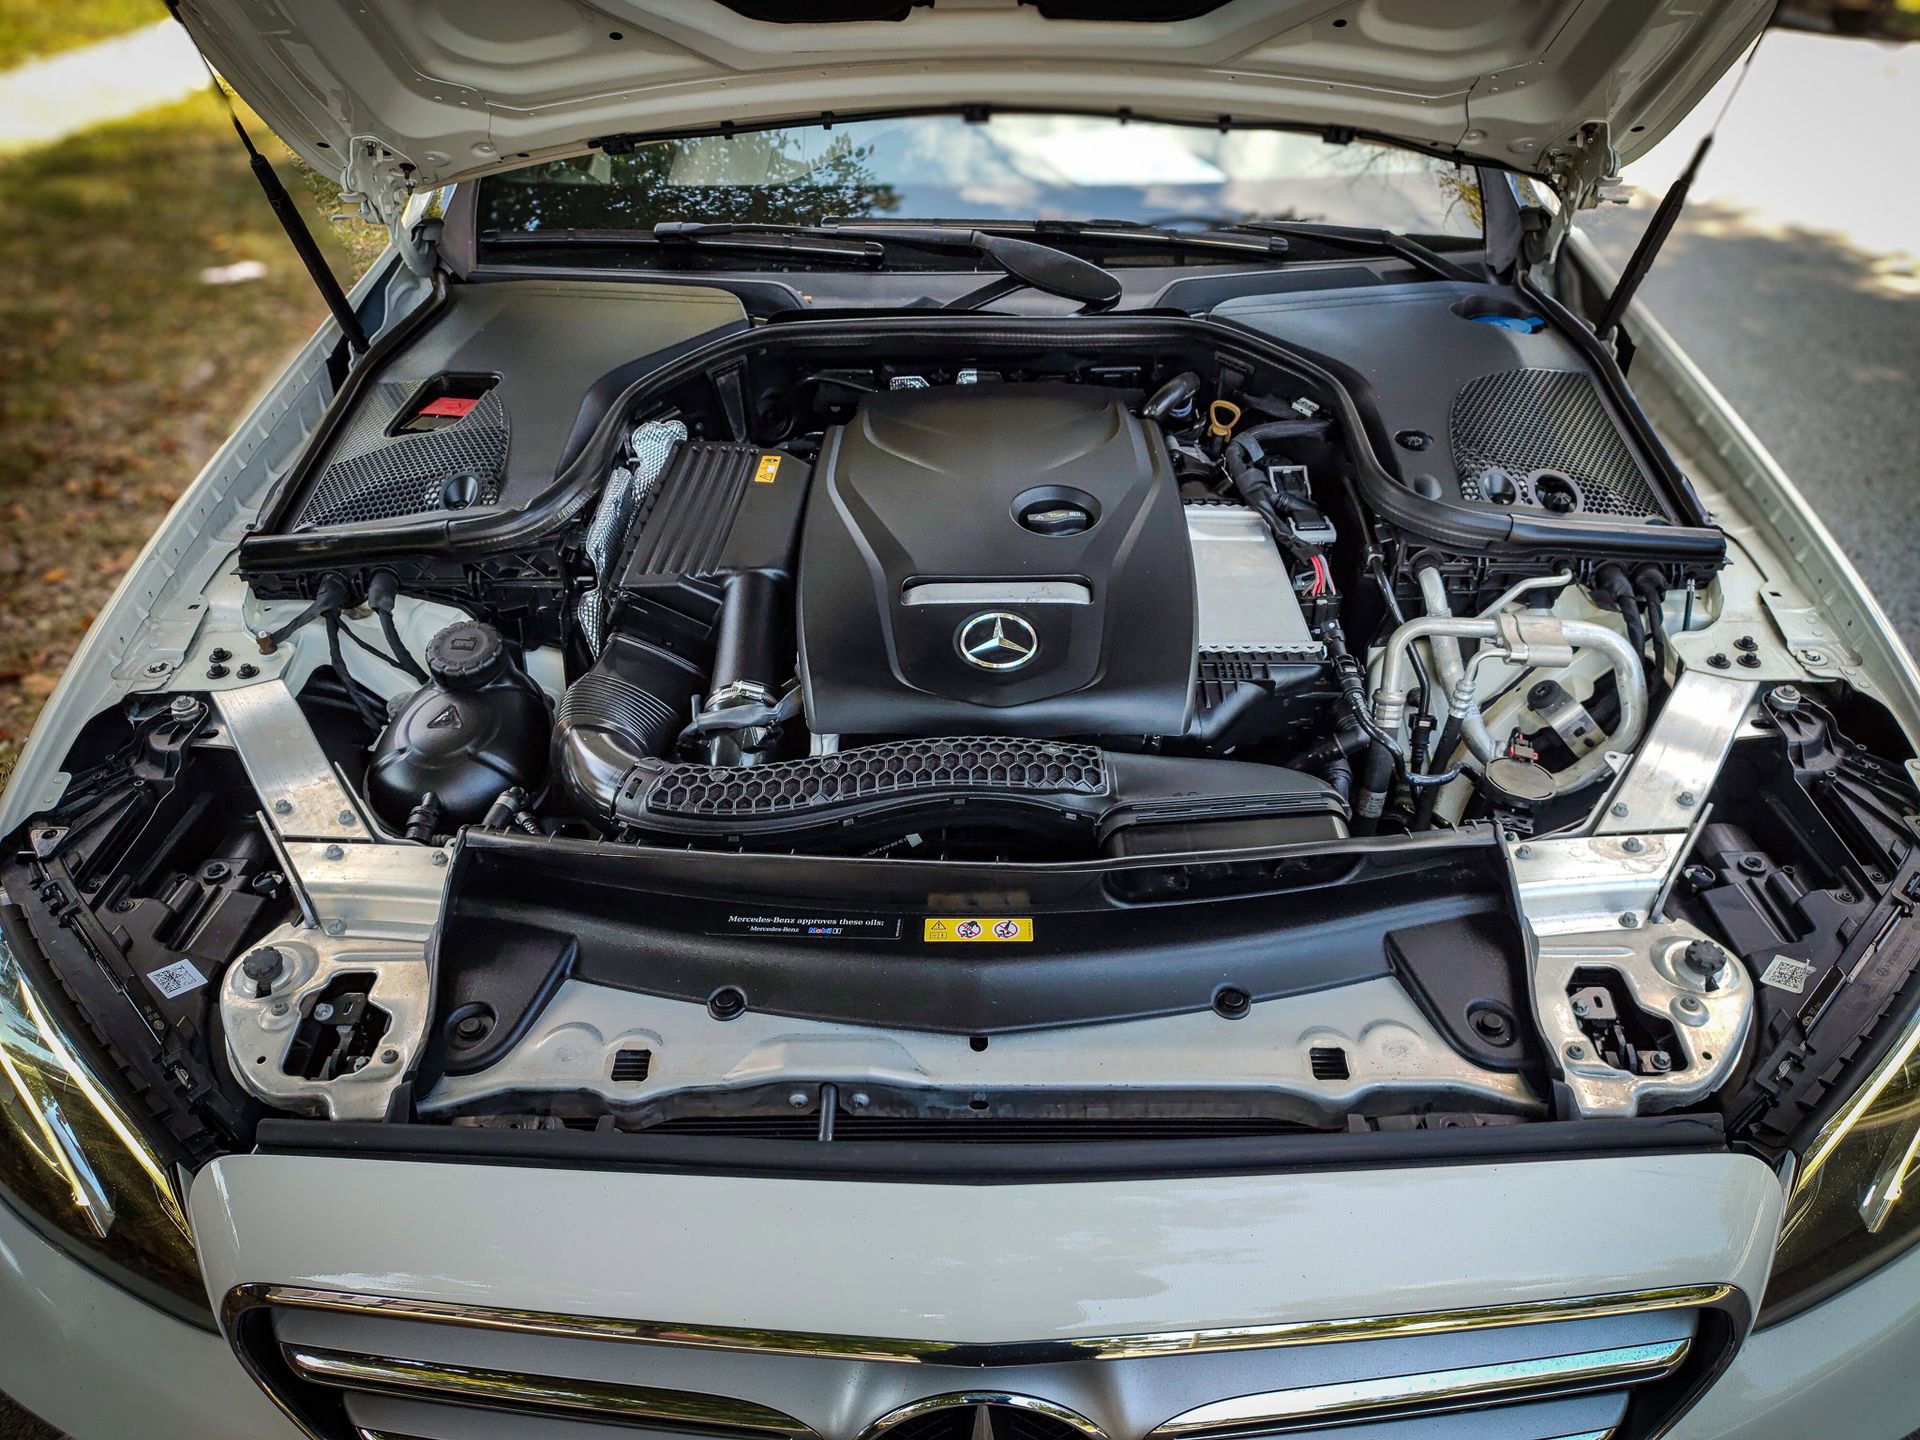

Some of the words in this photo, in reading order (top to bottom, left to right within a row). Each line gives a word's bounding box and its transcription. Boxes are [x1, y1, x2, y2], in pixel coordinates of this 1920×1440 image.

[728, 915, 796, 924] Mercedes-Benz
[797, 918, 837, 926] approves
[839, 918, 864, 926] these
[749, 925, 800, 933] Mercedes-Benz
